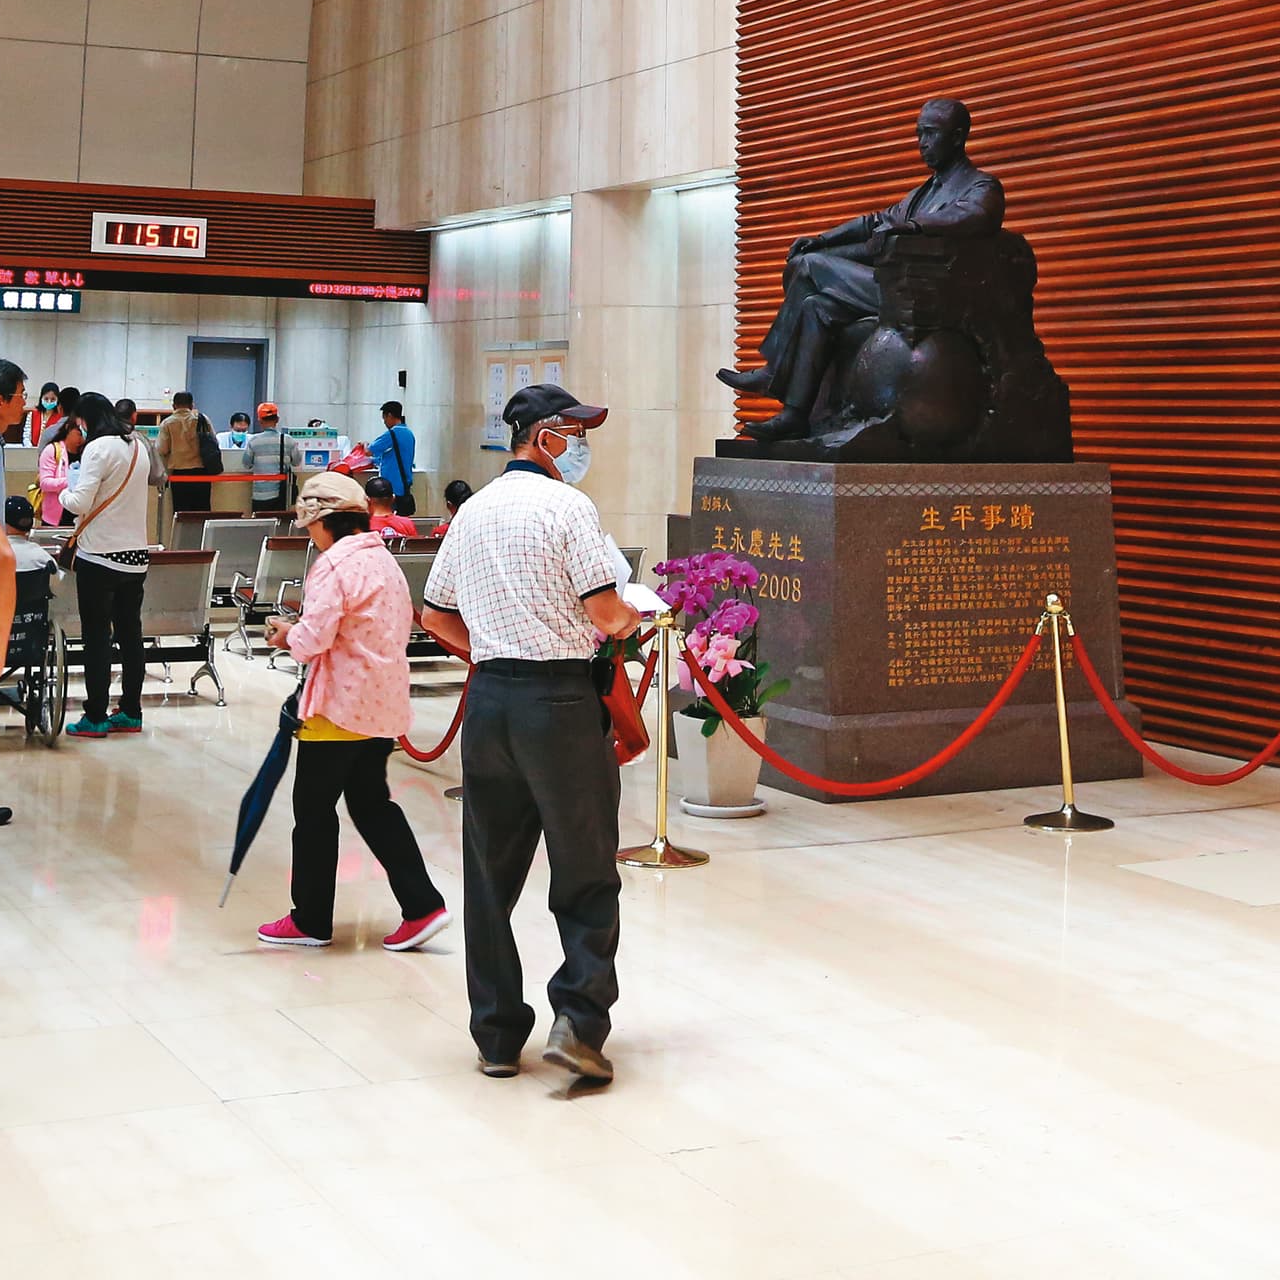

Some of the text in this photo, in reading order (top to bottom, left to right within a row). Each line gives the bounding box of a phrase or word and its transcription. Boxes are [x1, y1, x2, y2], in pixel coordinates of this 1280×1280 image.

[116, 223, 198, 249] 11519
[711, 525, 805, 562] 王永慶先生
